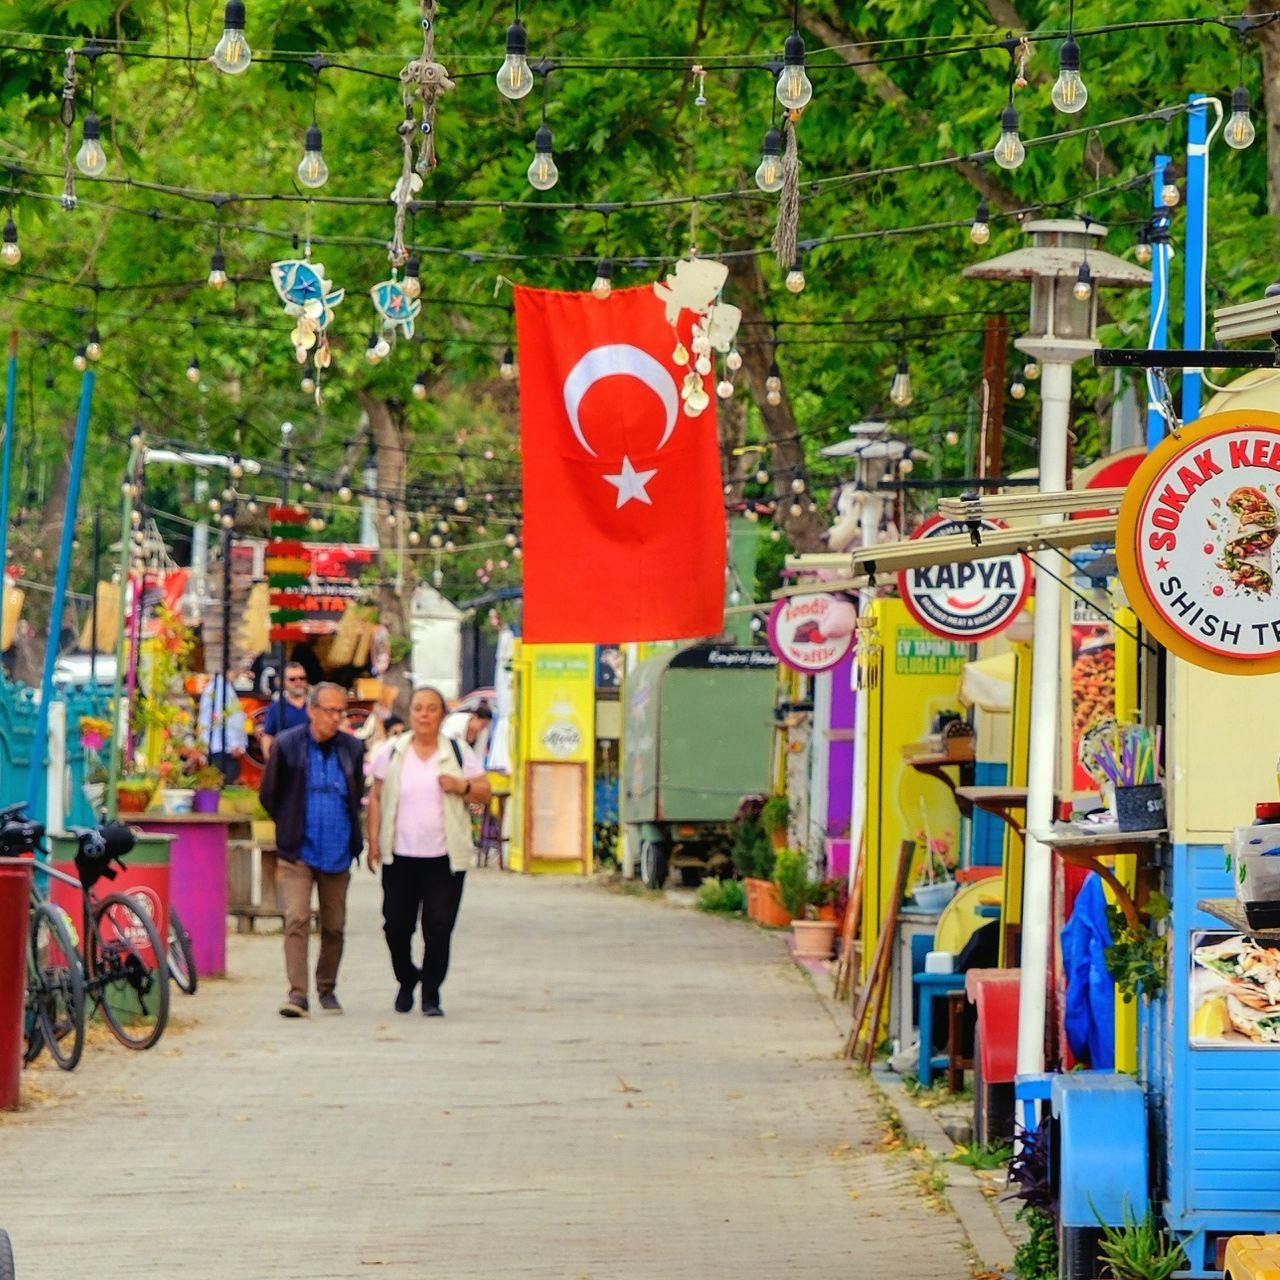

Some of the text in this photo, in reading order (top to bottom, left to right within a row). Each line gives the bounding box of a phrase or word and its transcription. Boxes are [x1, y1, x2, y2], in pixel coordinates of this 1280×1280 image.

[1149, 448, 1224, 552] SOKAK
[913, 560, 1016, 589] KAPYA
[1160, 576, 1241, 645] SHISH
